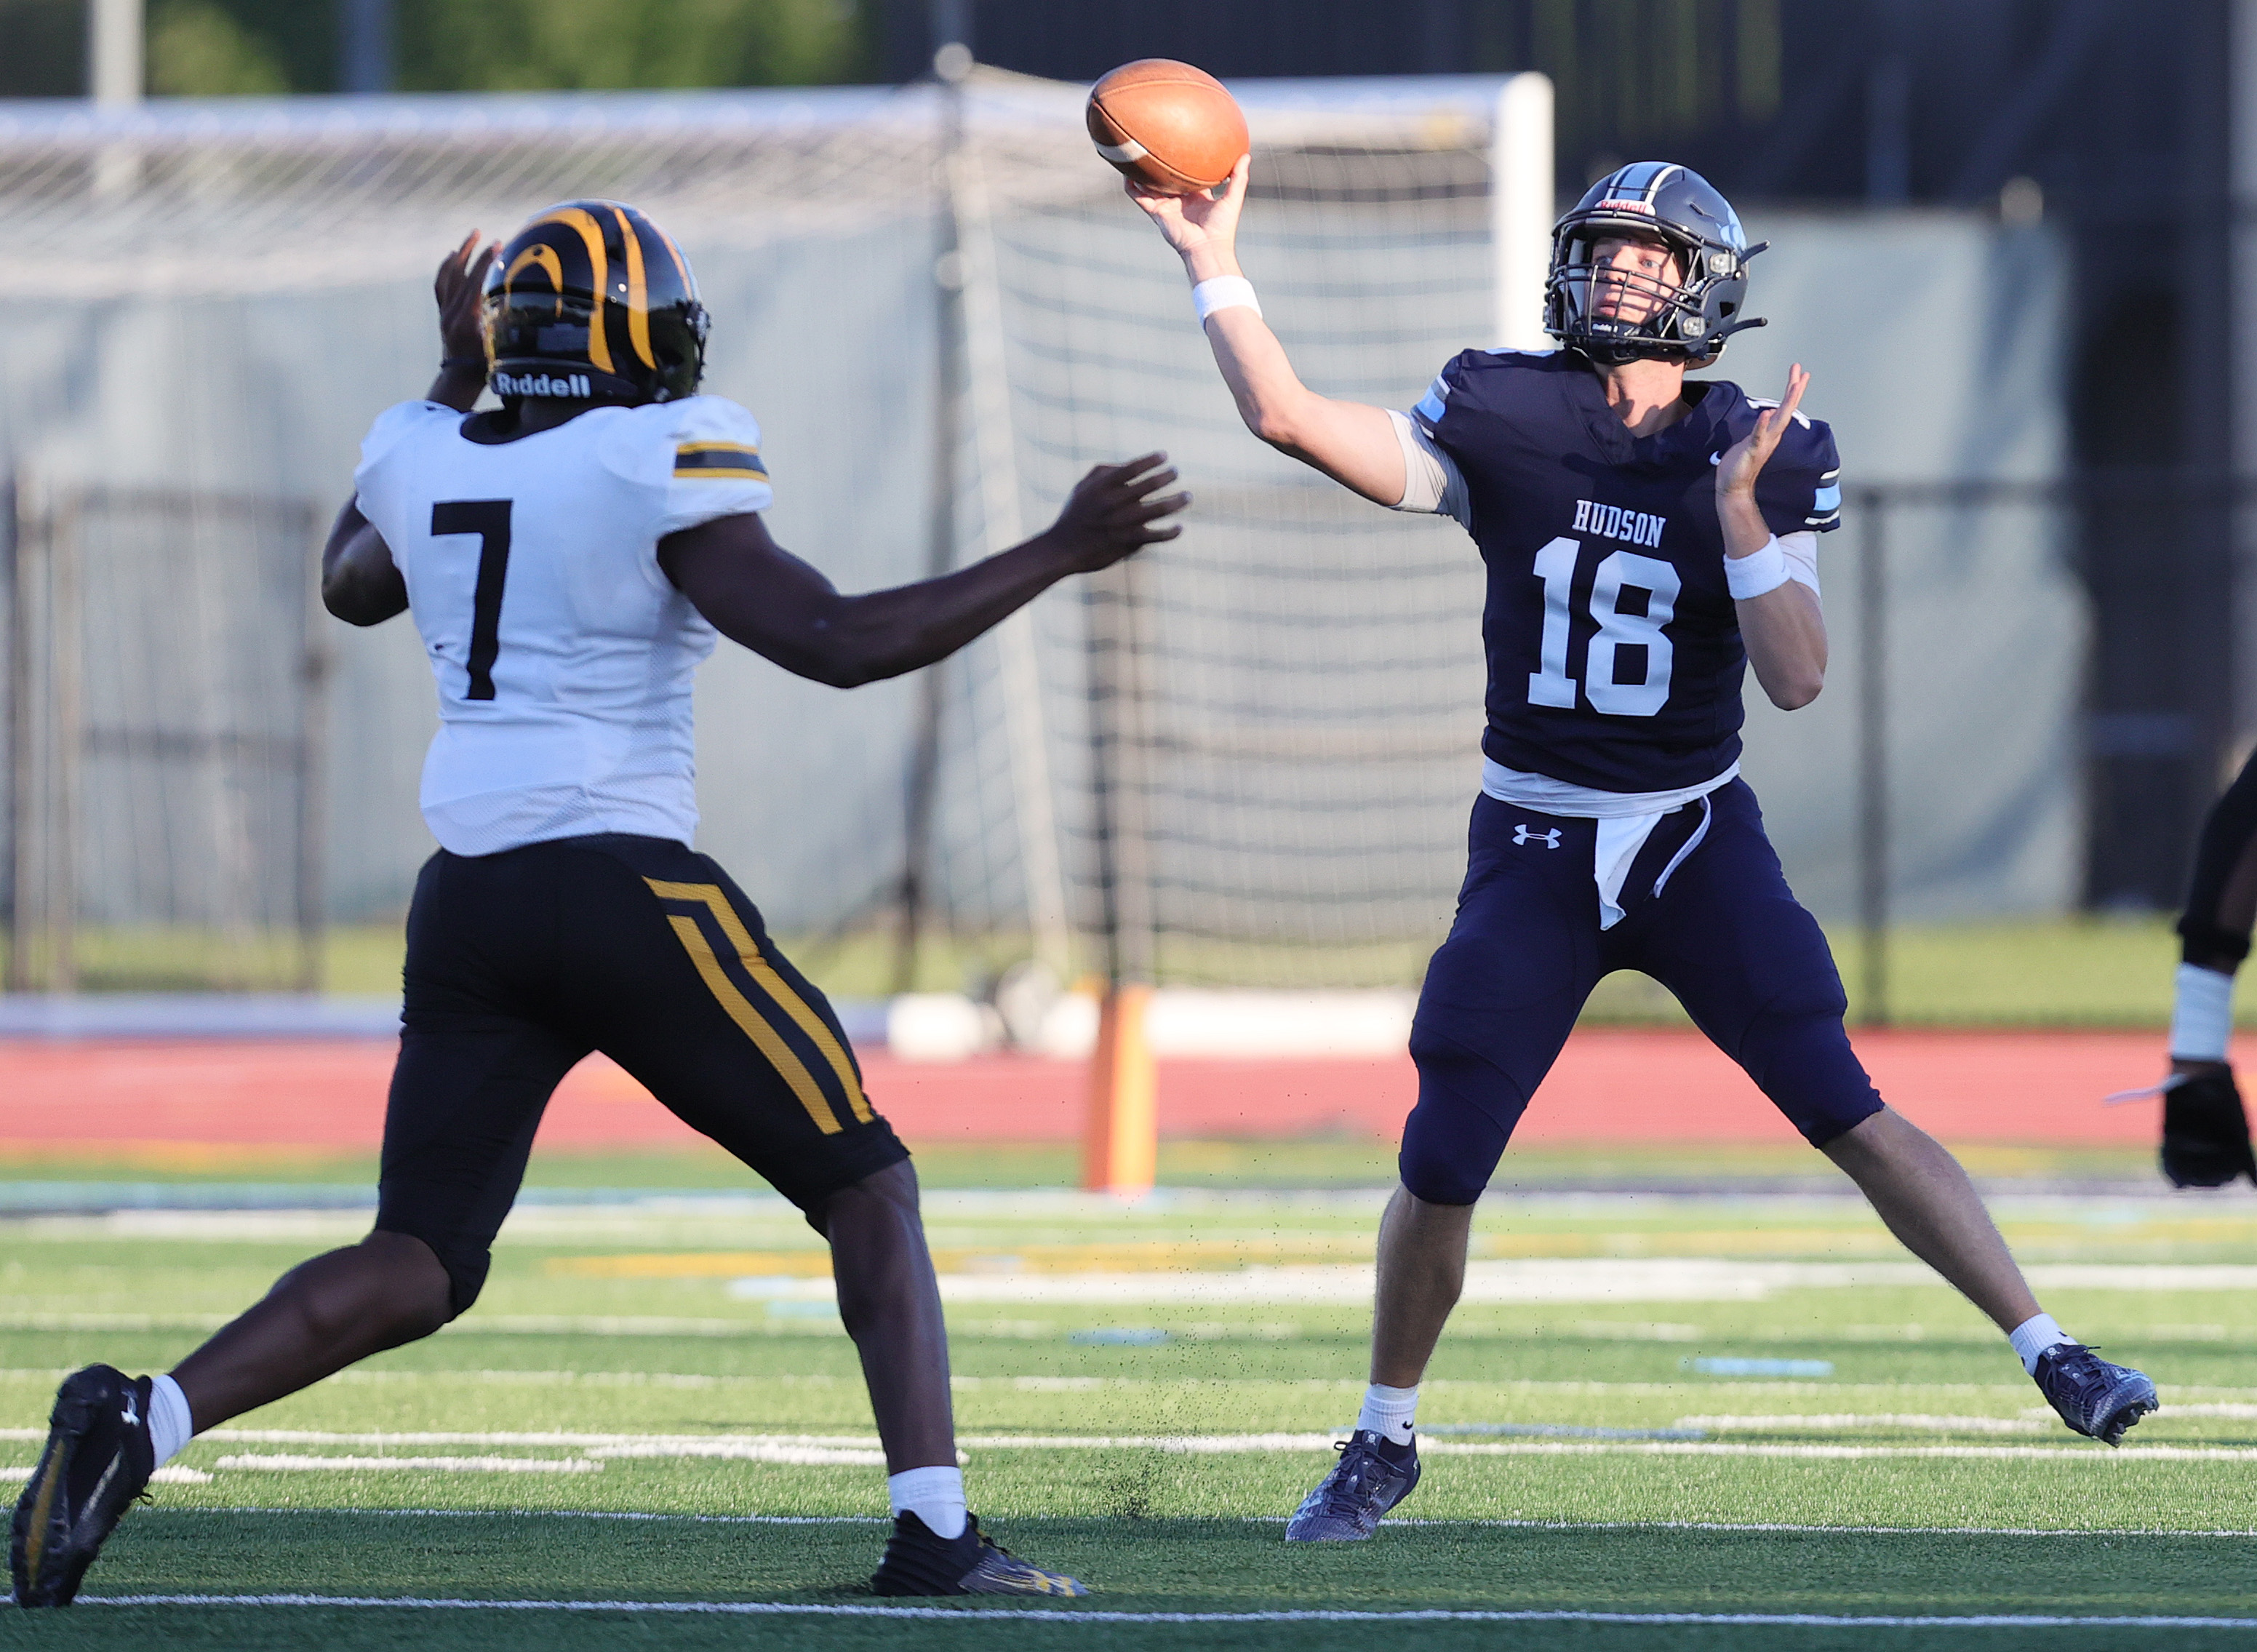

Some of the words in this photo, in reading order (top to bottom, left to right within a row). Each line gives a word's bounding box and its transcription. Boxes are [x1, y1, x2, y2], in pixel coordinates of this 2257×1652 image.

[496, 372, 591, 398] Riddell
[1572, 499, 1666, 548] HUDSON
[431, 499, 514, 701] 7
[1527, 536, 1682, 717] 18
